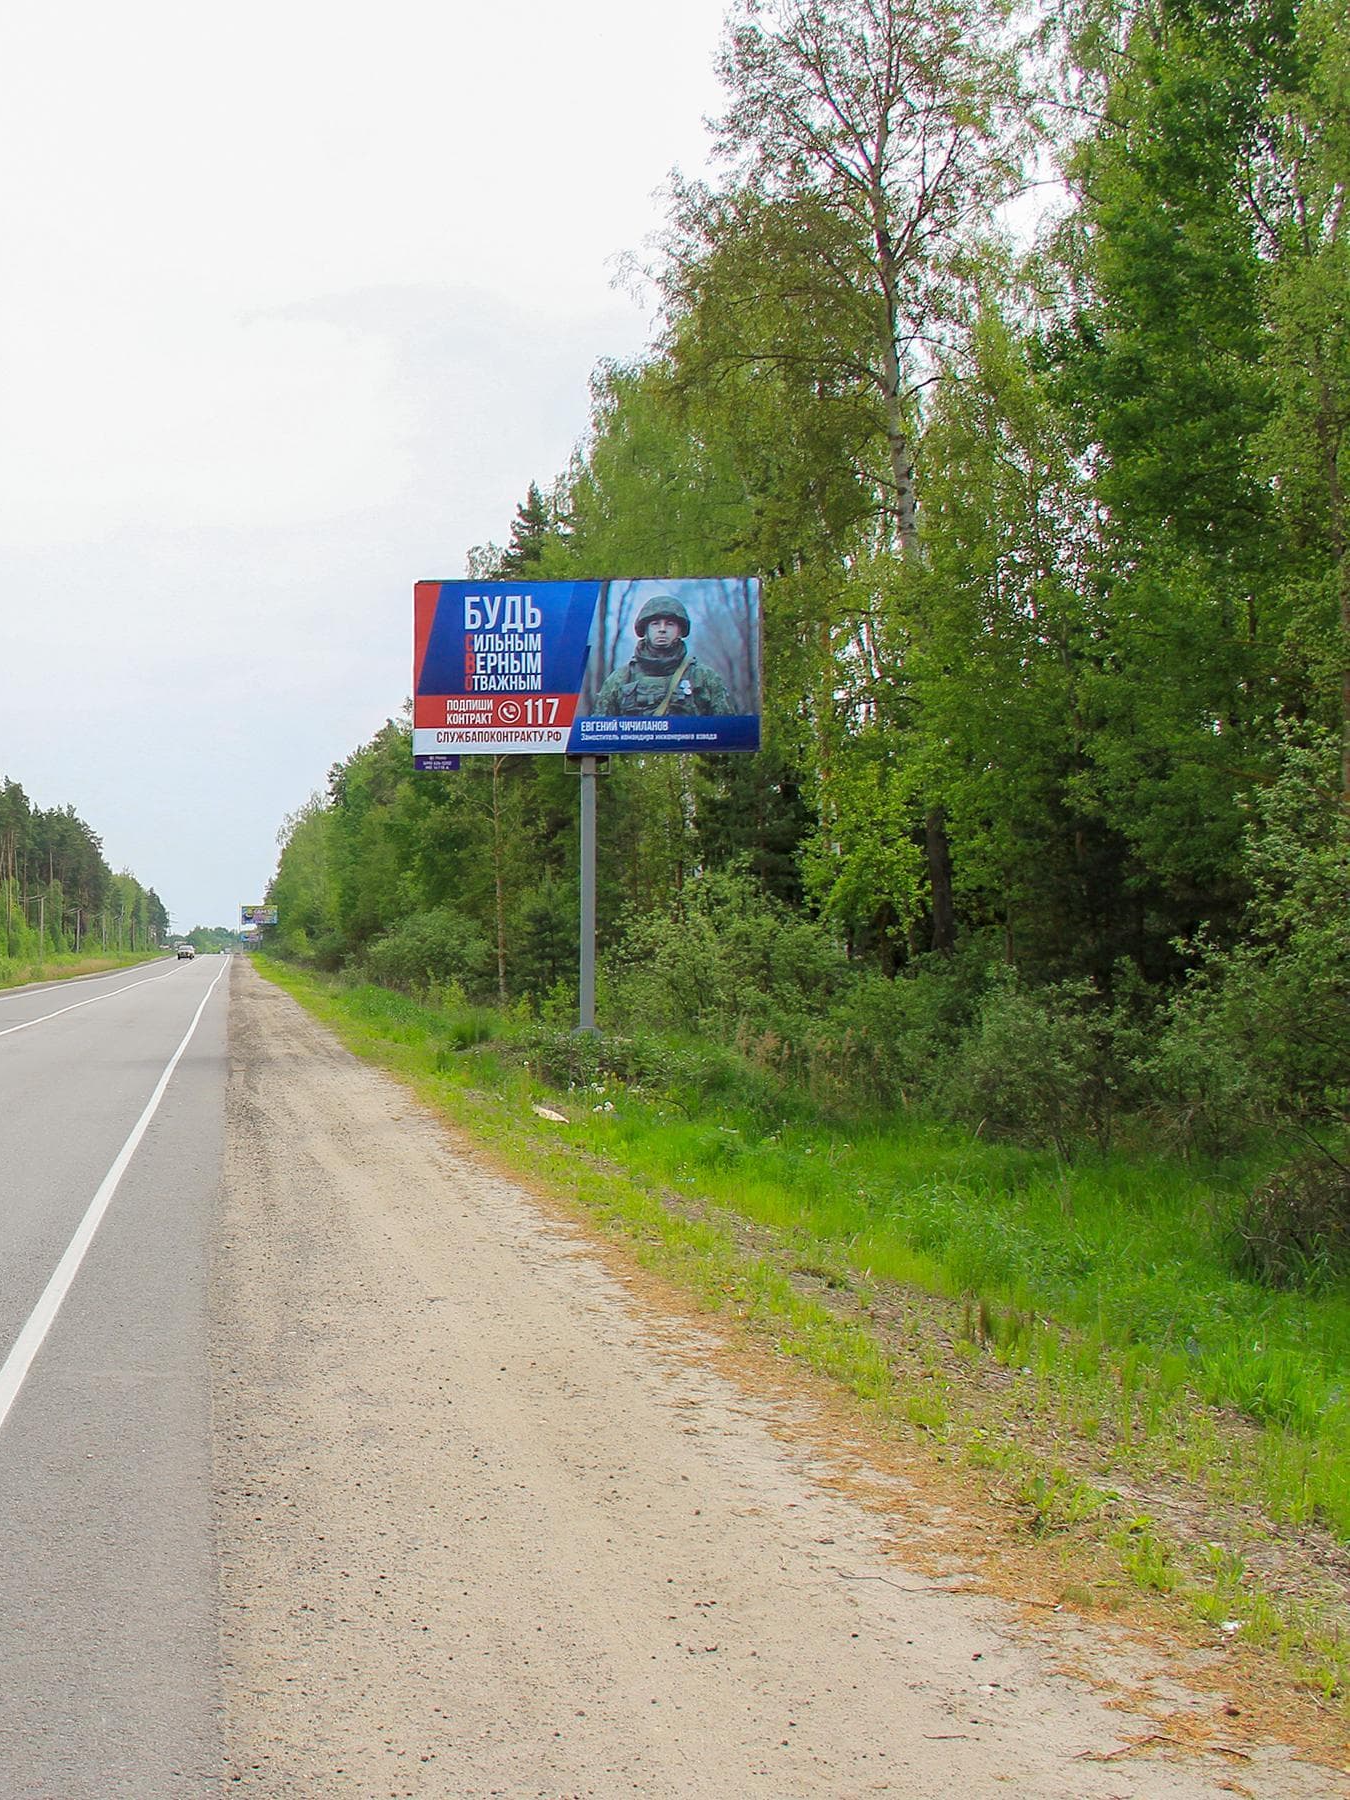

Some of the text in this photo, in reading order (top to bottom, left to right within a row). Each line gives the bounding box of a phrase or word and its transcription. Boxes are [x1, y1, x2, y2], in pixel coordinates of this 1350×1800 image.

[464, 595, 542, 633] БУДЬ
[464, 633, 542, 652] СИЛЬНЫМ
[464, 652, 542, 674] ВЕРНЫМ
[464, 674, 542, 691] ОТВАЖНЫМ
[446, 699, 493, 712] ПОДПИШИ
[524, 698, 560, 725] 117
[446, 713, 493, 725] КОНТРАКТ
[580, 720, 669, 732] ЕВГЕНИЙ ЧИЧИЛАНОВ
[436, 731, 562, 743] СЛУЖБАПОКОНТРАКТУ.РФ
